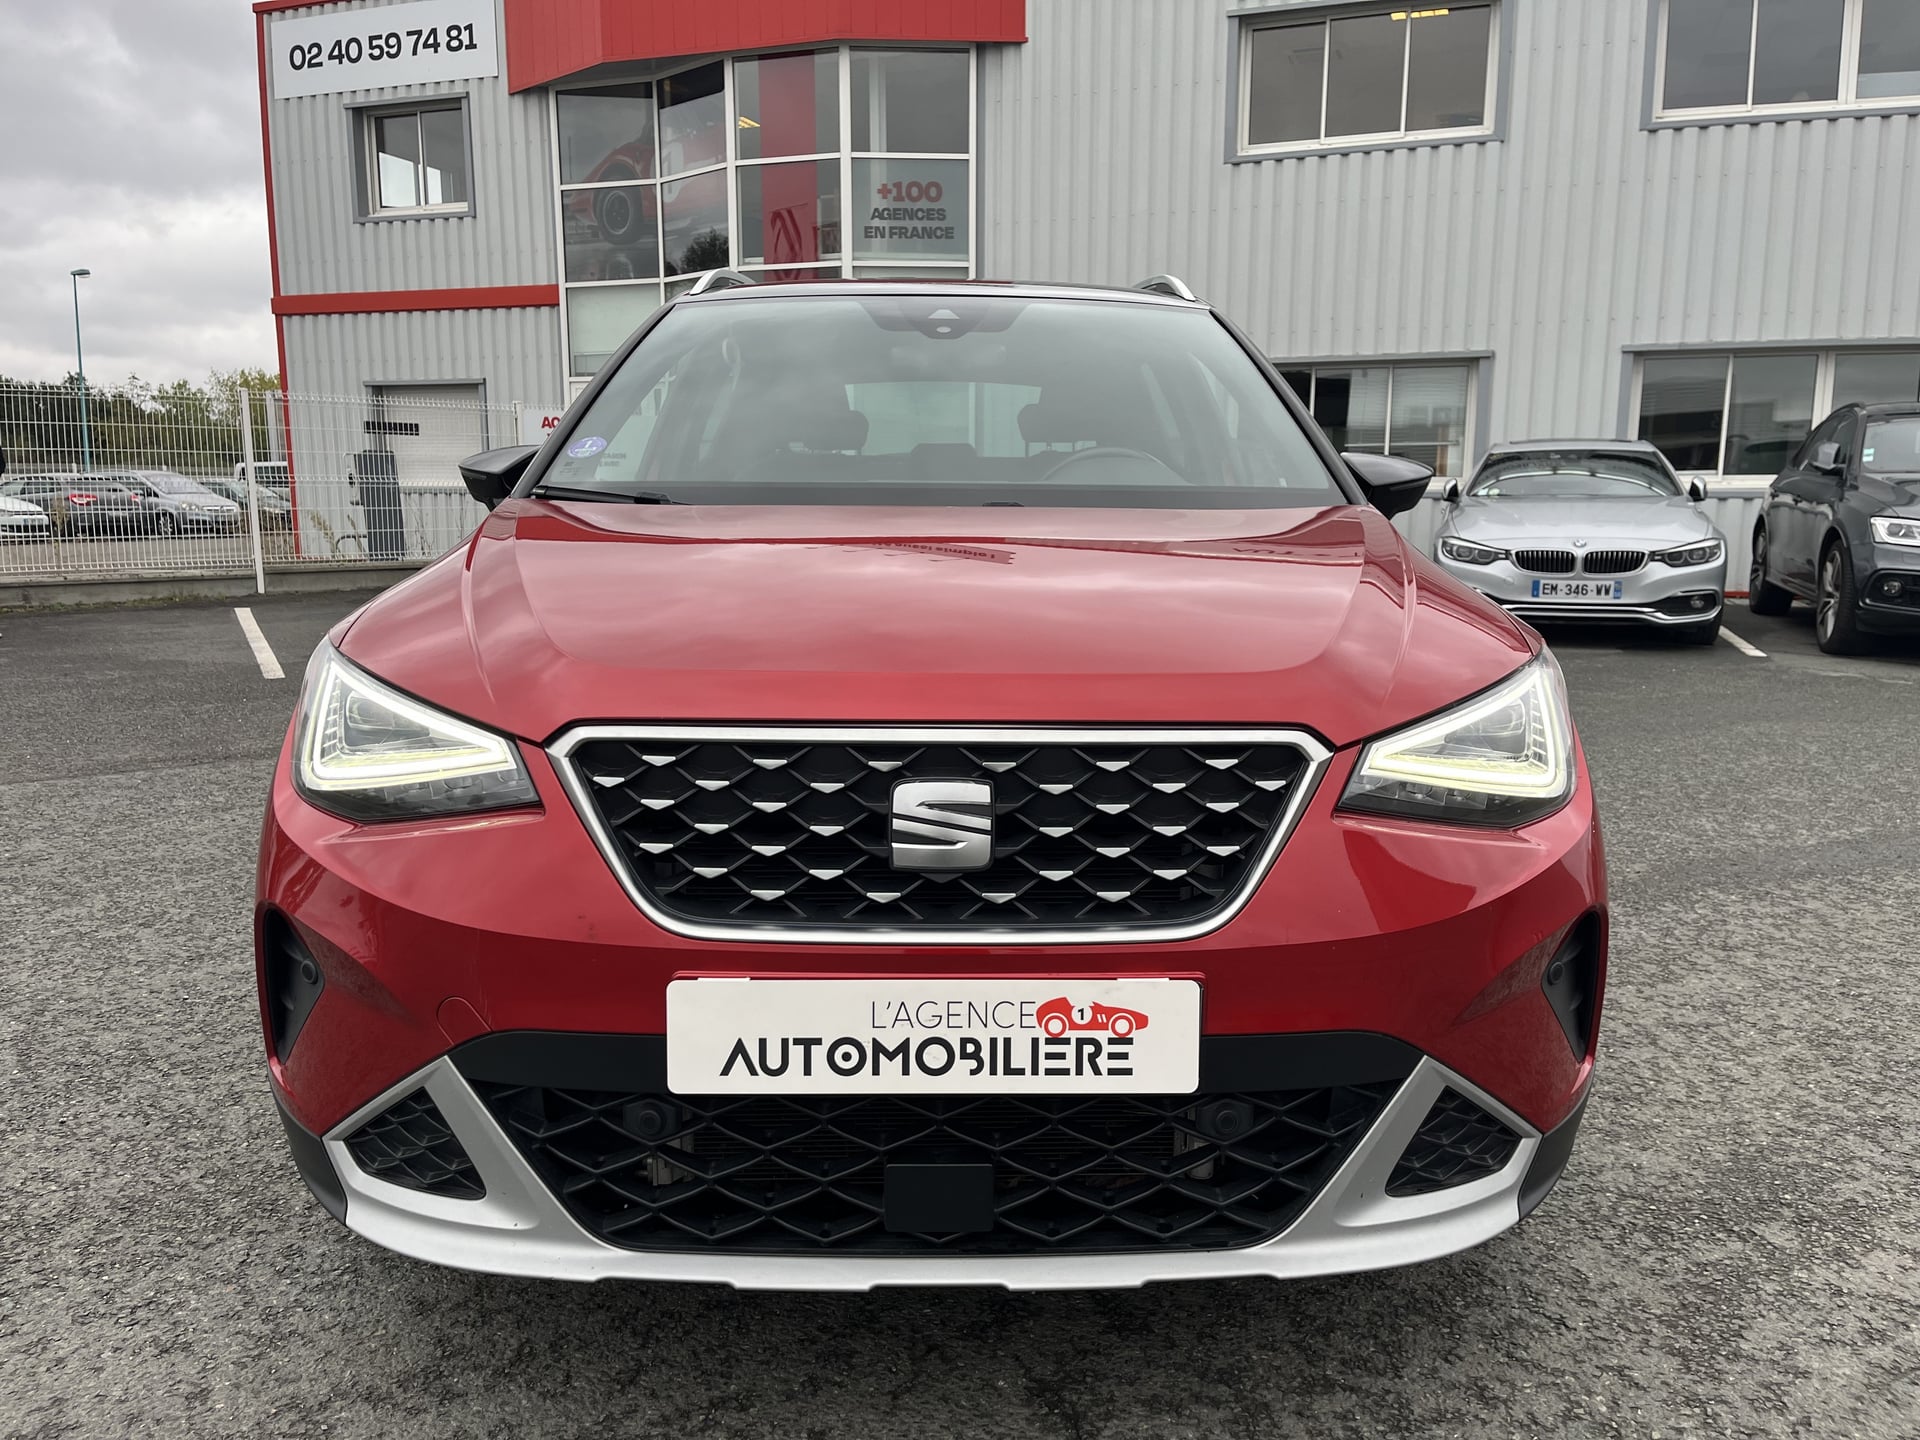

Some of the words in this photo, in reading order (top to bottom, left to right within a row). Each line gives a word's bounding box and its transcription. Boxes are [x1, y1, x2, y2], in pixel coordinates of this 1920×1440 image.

[289, 42, 323, 70] 02
[328, 37, 363, 64] 40
[368, 32, 402, 60] 59
[406, 27, 440, 56] 74
[446, 23, 477, 52] 81
[876, 181, 943, 203] +100
[870, 207, 947, 221] AGENCES
[863, 225, 886, 239] EN
[888, 226, 955, 239] FRANCE
